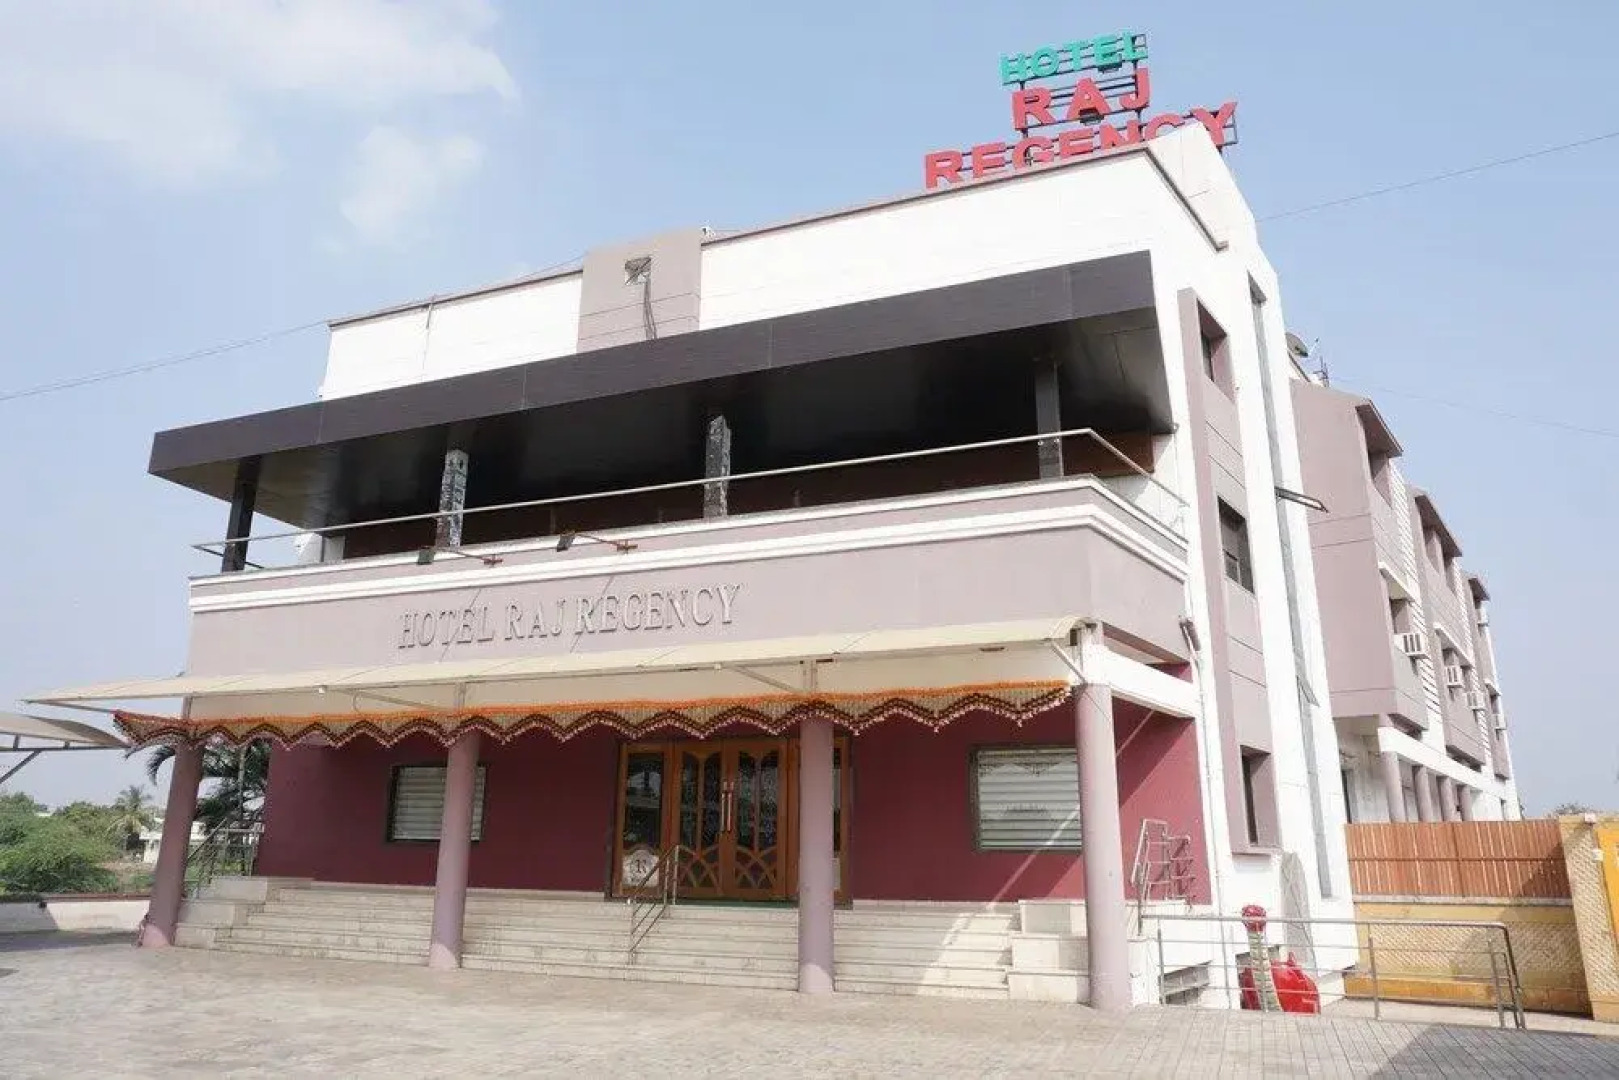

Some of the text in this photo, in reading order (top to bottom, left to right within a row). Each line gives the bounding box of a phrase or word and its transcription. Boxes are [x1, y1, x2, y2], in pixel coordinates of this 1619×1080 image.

[1001, 31, 1147, 84] HOTEL
[1012, 68, 1149, 130] RAJ
[925, 101, 1237, 188] REGENCY
[398, 581, 741, 649] HOTEL RAJ REGENCY
